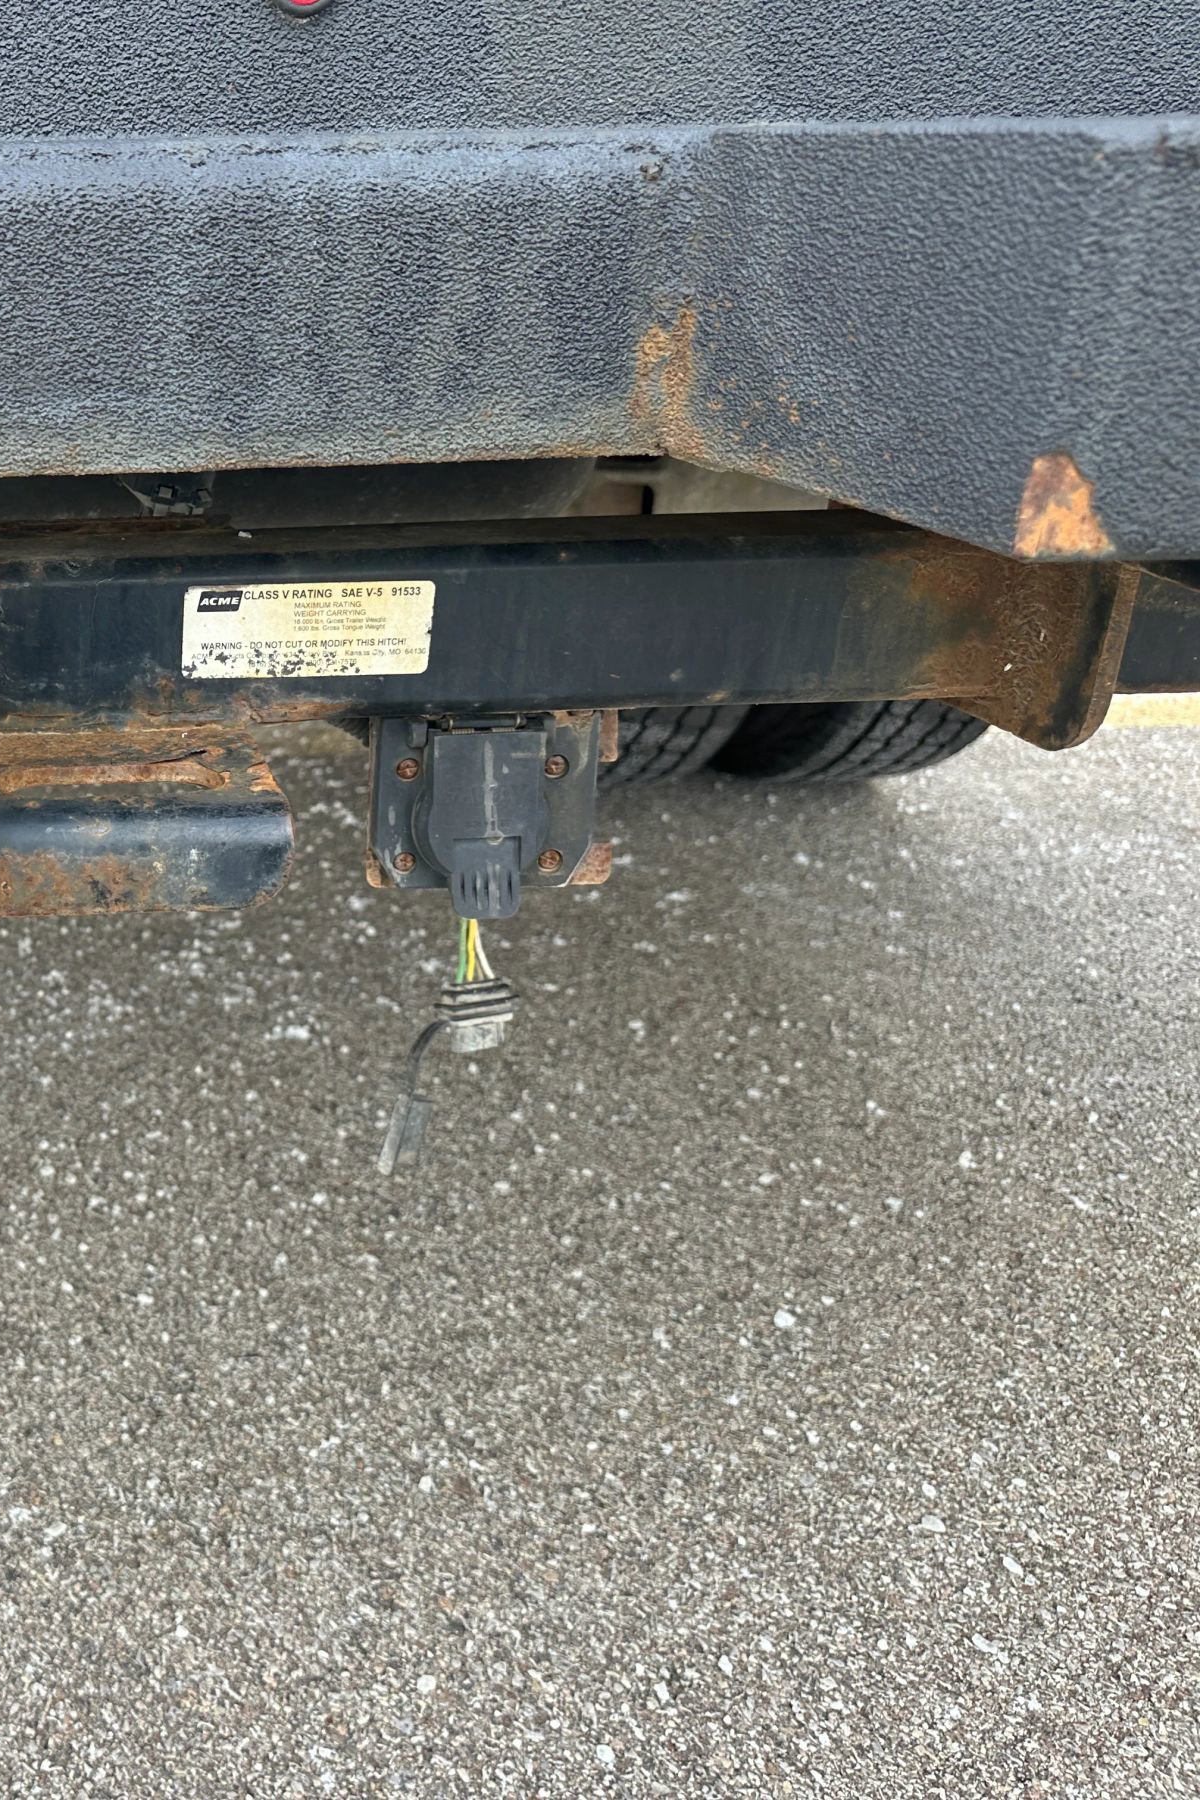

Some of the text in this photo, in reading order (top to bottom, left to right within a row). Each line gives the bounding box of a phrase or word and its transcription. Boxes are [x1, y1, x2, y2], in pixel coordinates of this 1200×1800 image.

[243, 586, 421, 600] CLASS V RATING SAE V-5 91533
[200, 597, 240, 606] ACME
[200, 641, 242, 650] WARNING
[249, 641, 262, 649] DO
[265, 640, 283, 649] NOT
[285, 640, 303, 648] CUT
[305, 640, 318, 648] OR
[320, 639, 354, 648] MODIFY
[357, 638, 375, 646] THIS
[377, 637, 407, 646] HITCH!
